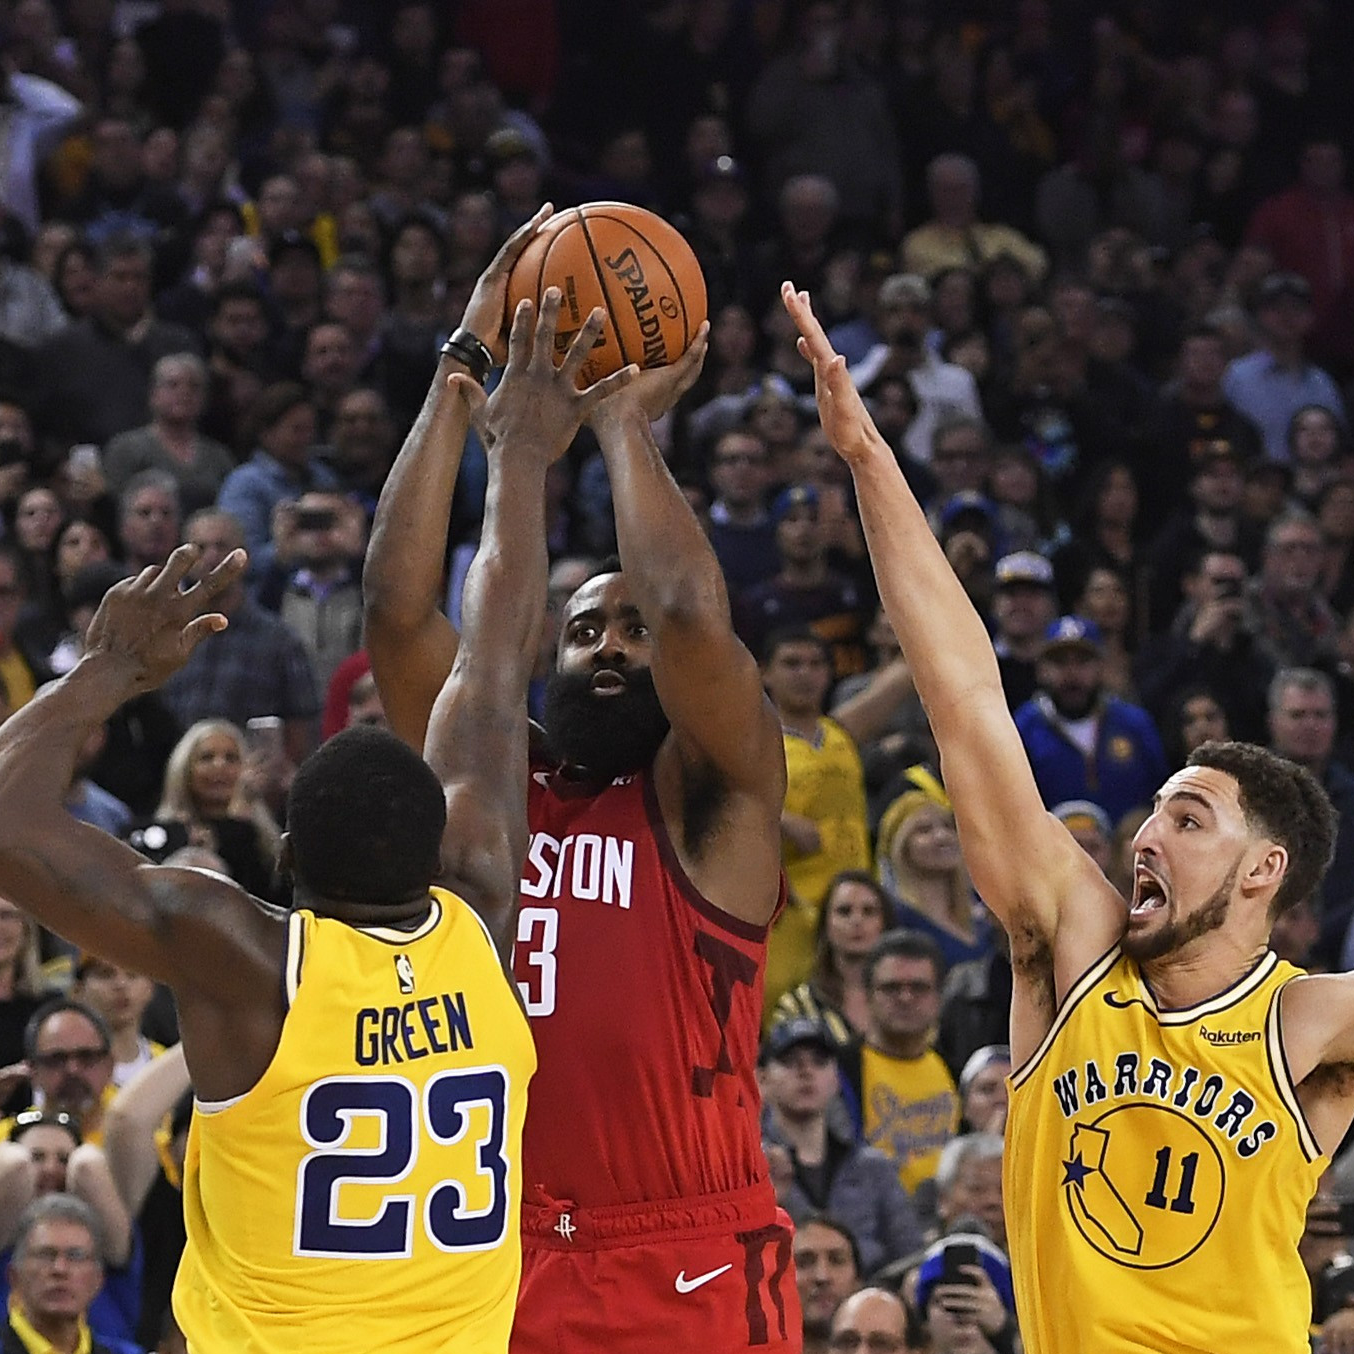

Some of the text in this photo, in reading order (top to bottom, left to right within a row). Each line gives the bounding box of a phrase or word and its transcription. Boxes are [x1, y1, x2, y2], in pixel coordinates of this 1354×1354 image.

[355, 992, 474, 1067] GREEN
[1198, 1025, 1262, 1047] Rakuten
[1052, 1052, 1277, 1160] WARRIORS
[292, 1063, 511, 1260] 23
[1144, 1145, 1200, 1215] 11
